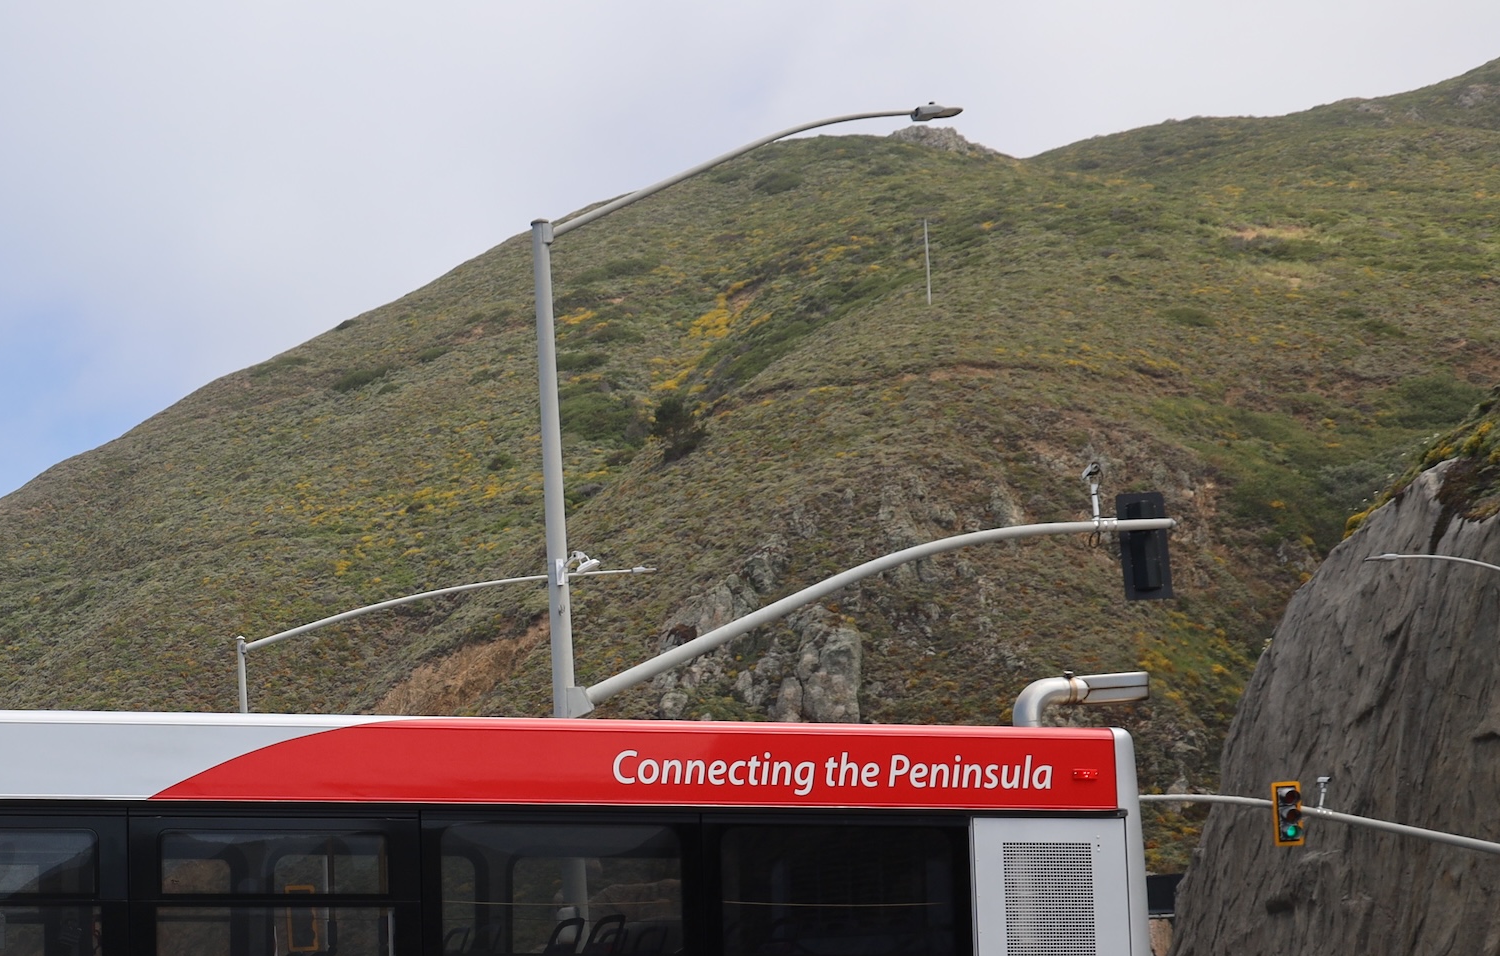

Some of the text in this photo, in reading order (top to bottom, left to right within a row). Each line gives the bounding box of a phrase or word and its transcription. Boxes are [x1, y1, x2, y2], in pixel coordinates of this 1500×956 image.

[612, 749, 1053, 796] Connecting the Peninsula
